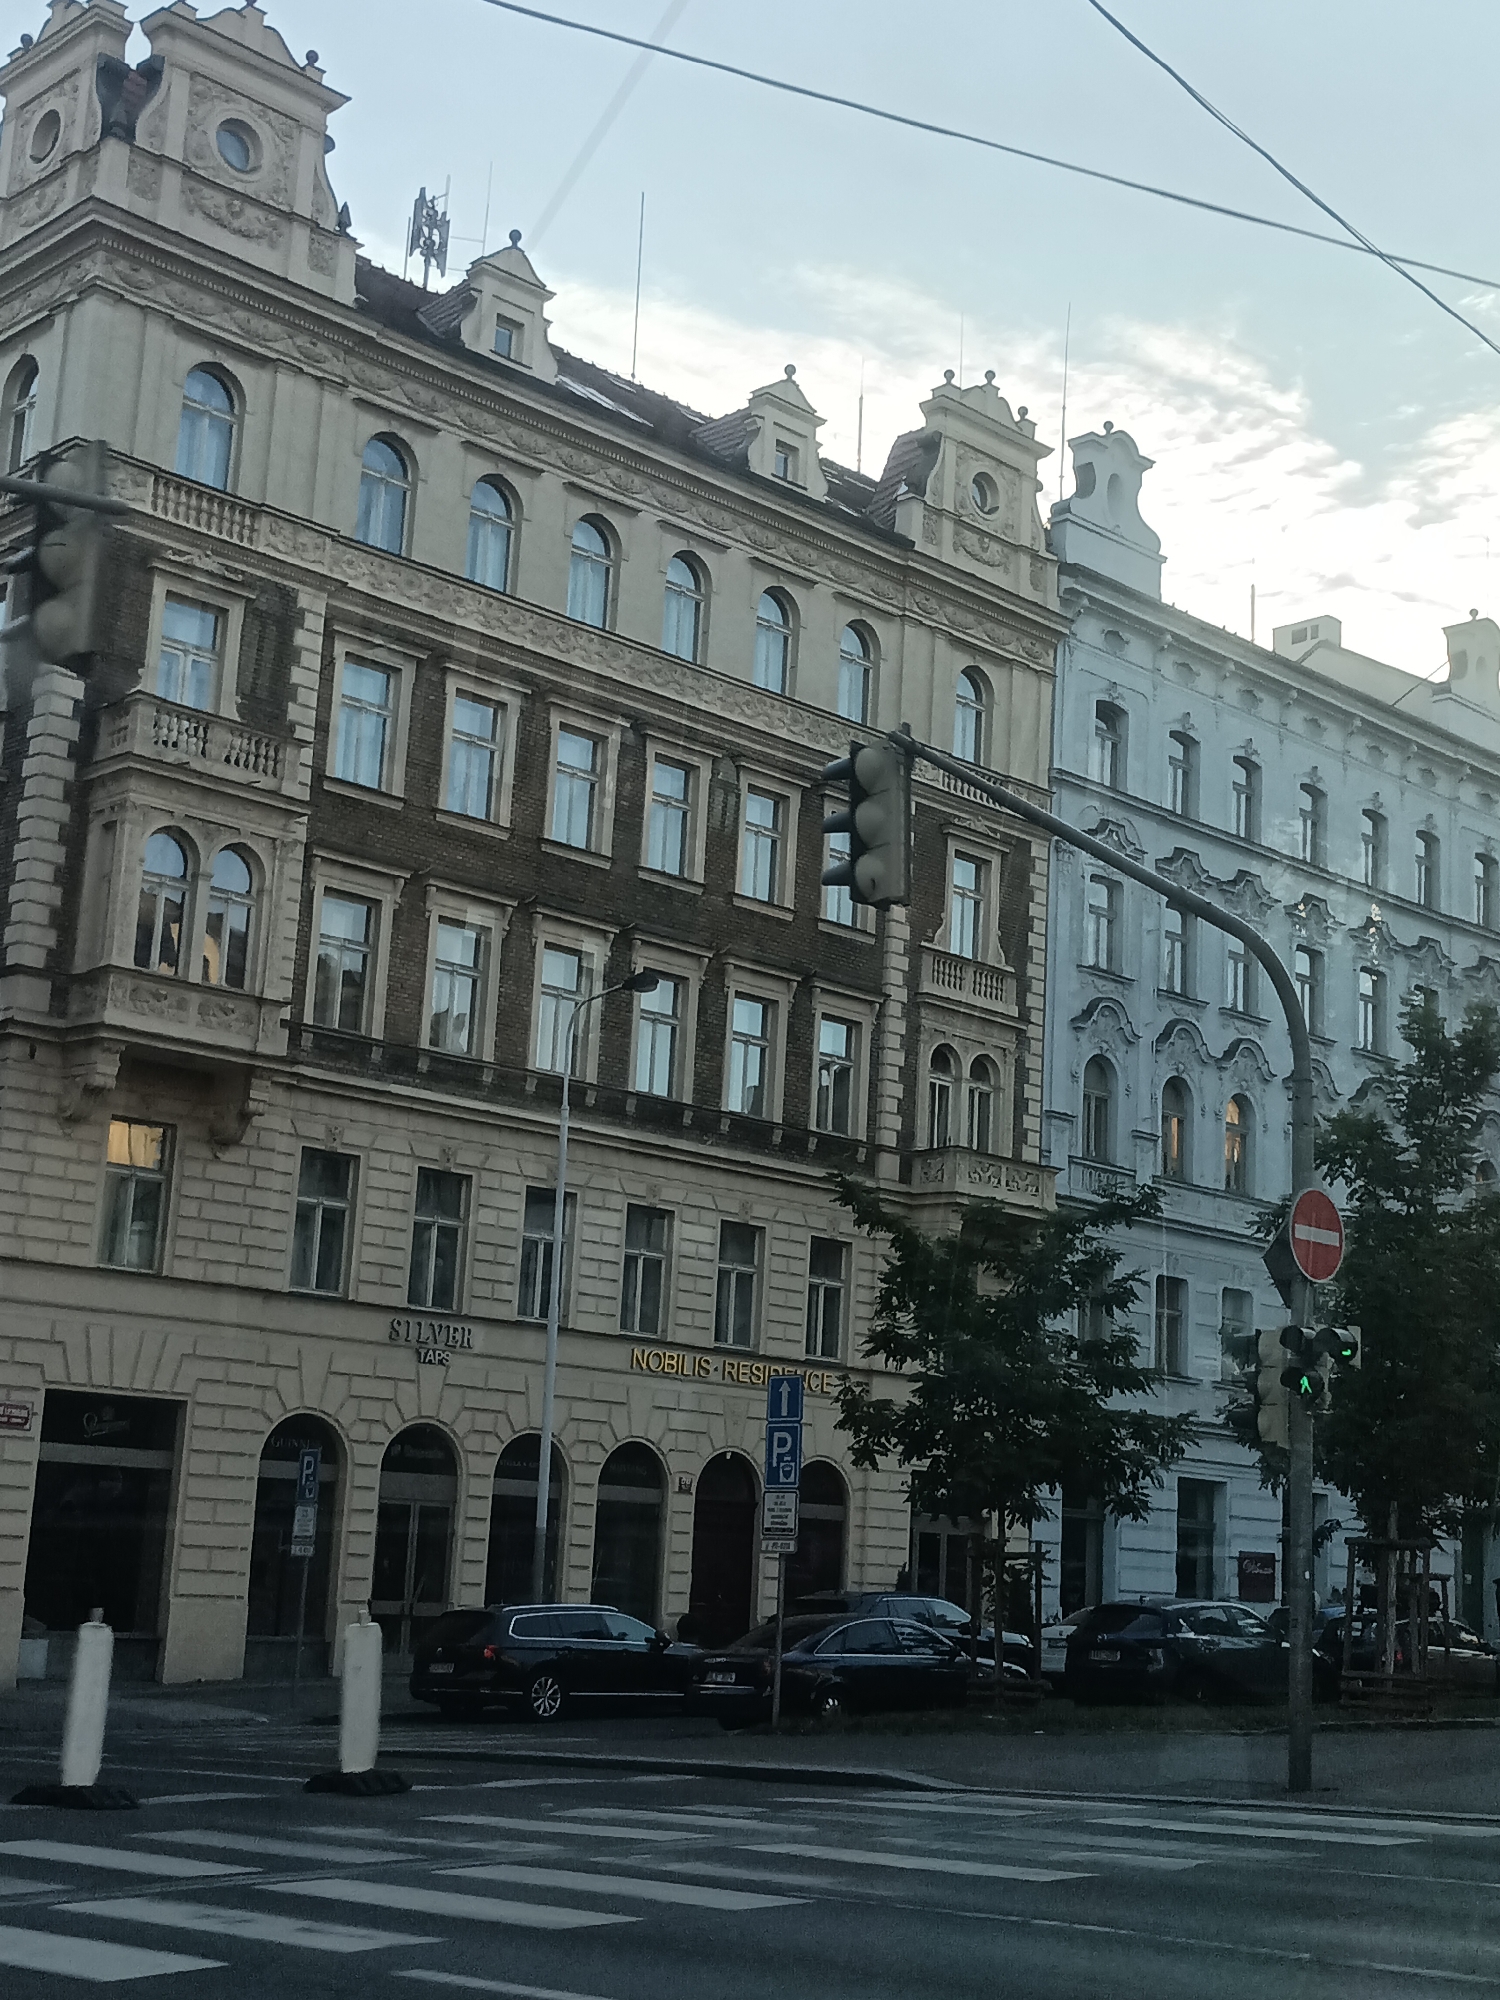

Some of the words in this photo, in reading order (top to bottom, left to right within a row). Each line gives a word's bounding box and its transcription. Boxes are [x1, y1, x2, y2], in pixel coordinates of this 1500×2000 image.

[389, 1318, 473, 1349] SILVER
[416, 1347, 451, 1366] TAPS
[630, 1347, 711, 1378] NOBILIS
[771, 1431, 792, 1468] P
[302, 1455, 314, 1486] P
